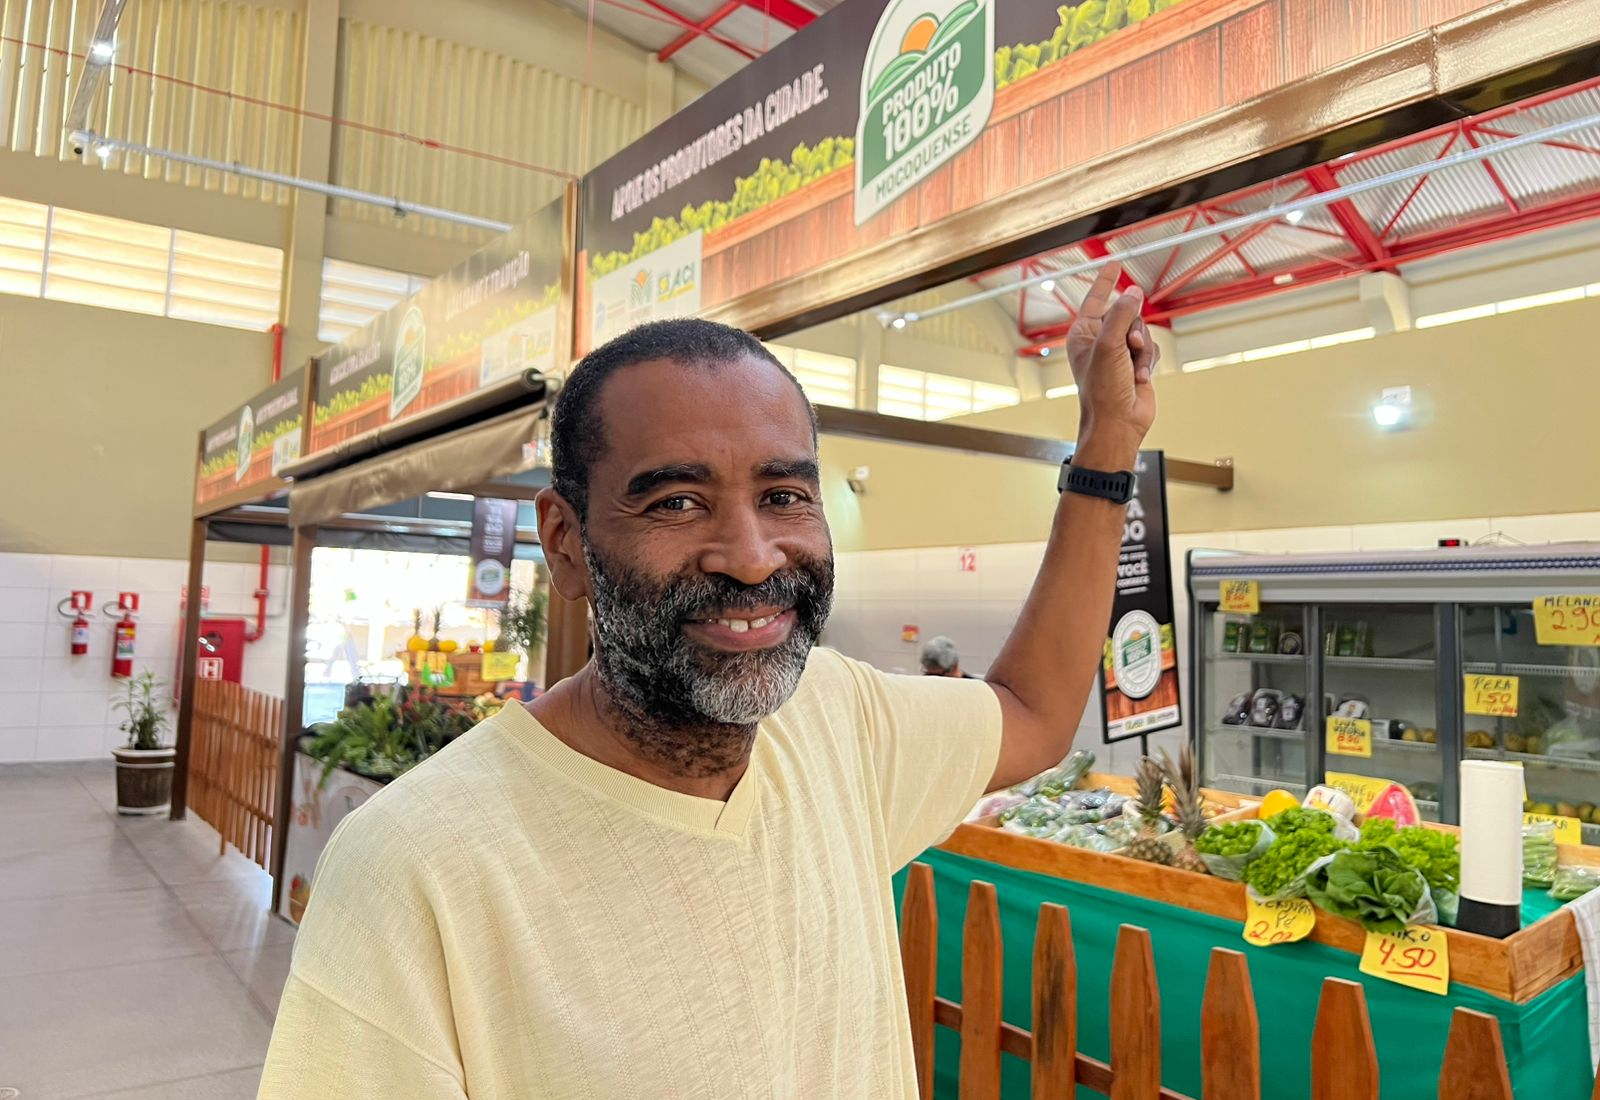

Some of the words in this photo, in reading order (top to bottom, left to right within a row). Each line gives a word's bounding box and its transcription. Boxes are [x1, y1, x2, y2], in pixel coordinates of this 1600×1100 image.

[882, 42, 961, 125] PRODUTO
[643, 163, 660, 203] OS
[660, 112, 743, 194] PRODUTORES
[743, 101, 765, 145] DA
[765, 62, 829, 132] CIDADE.
[883, 70, 959, 161] 100%
[875, 113, 971, 202] MOCOQUENSE
[961, 553, 976, 571] 12
[1117, 559, 1149, 578] VOCÊ
[204, 660, 219, 678] H
[1379, 938, 1436, 969] 4.50
